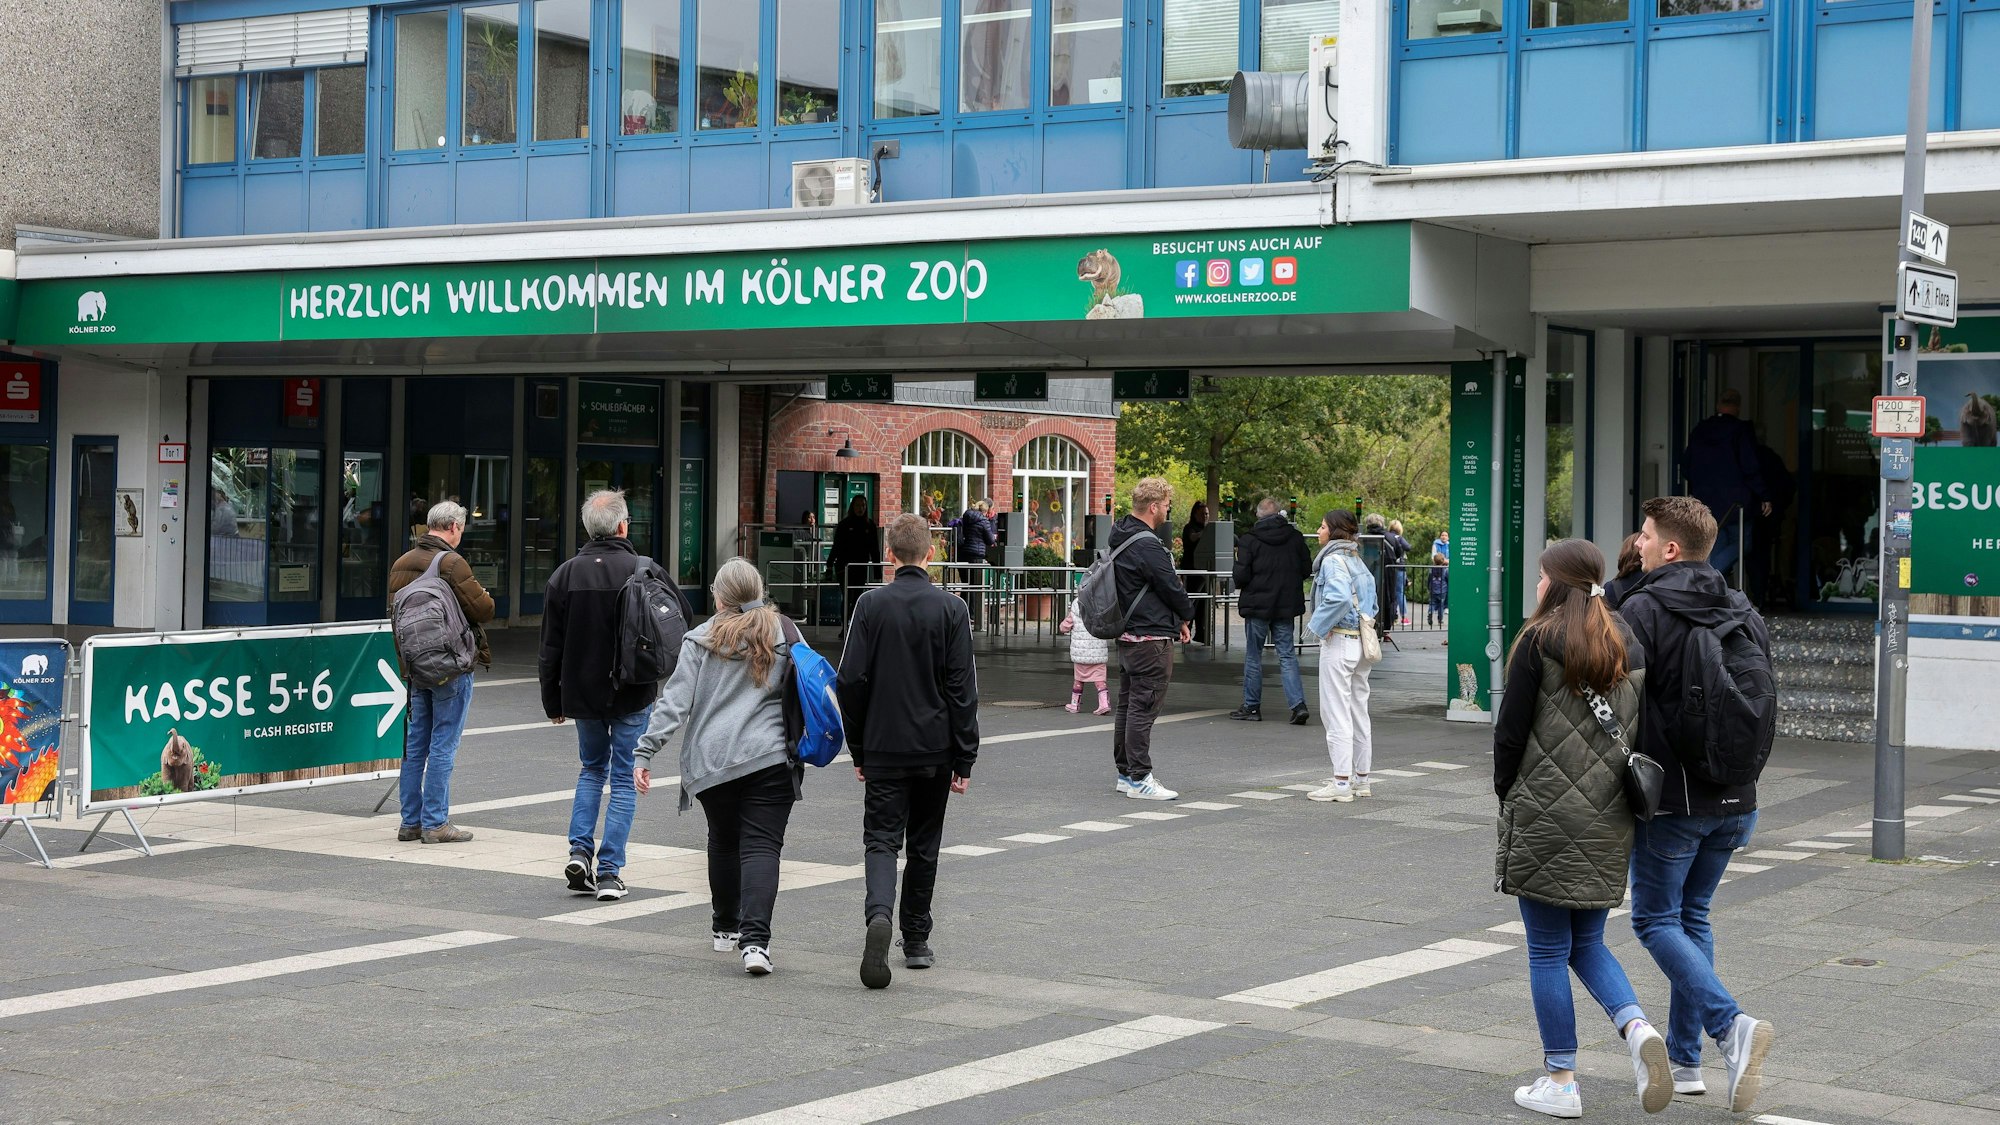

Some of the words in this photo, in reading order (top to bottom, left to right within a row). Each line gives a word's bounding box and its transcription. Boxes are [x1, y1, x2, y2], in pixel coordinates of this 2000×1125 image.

[1912, 224, 1927, 246] 140
[1152, 240, 1214, 255] BESUCHT
[1217, 239, 1246, 252] UNS
[1250, 237, 1290, 251] AUCH
[1293, 236, 1323, 250] AUF
[289, 281, 431, 320] HERZLICH
[446, 271, 668, 314] WILLKOMMEN
[685, 268, 724, 306] IM
[741, 258, 886, 306] KÖLNER
[906, 259, 988, 301] ZOO
[1174, 291, 1297, 304] WWW.KOELNERZOO.DE
[1935, 287, 1950, 307] Flora
[68, 325, 99, 334] KÖLNER
[100, 325, 116, 333] ZOO
[1899, 336, 1906, 347] 3
[1911, 482, 2000, 510] BESU
[124, 674, 256, 725] KASSE
[267, 668, 334, 714] 5+6
[253, 726, 282, 739] CASH
[284, 721, 334, 737] REGISTER
